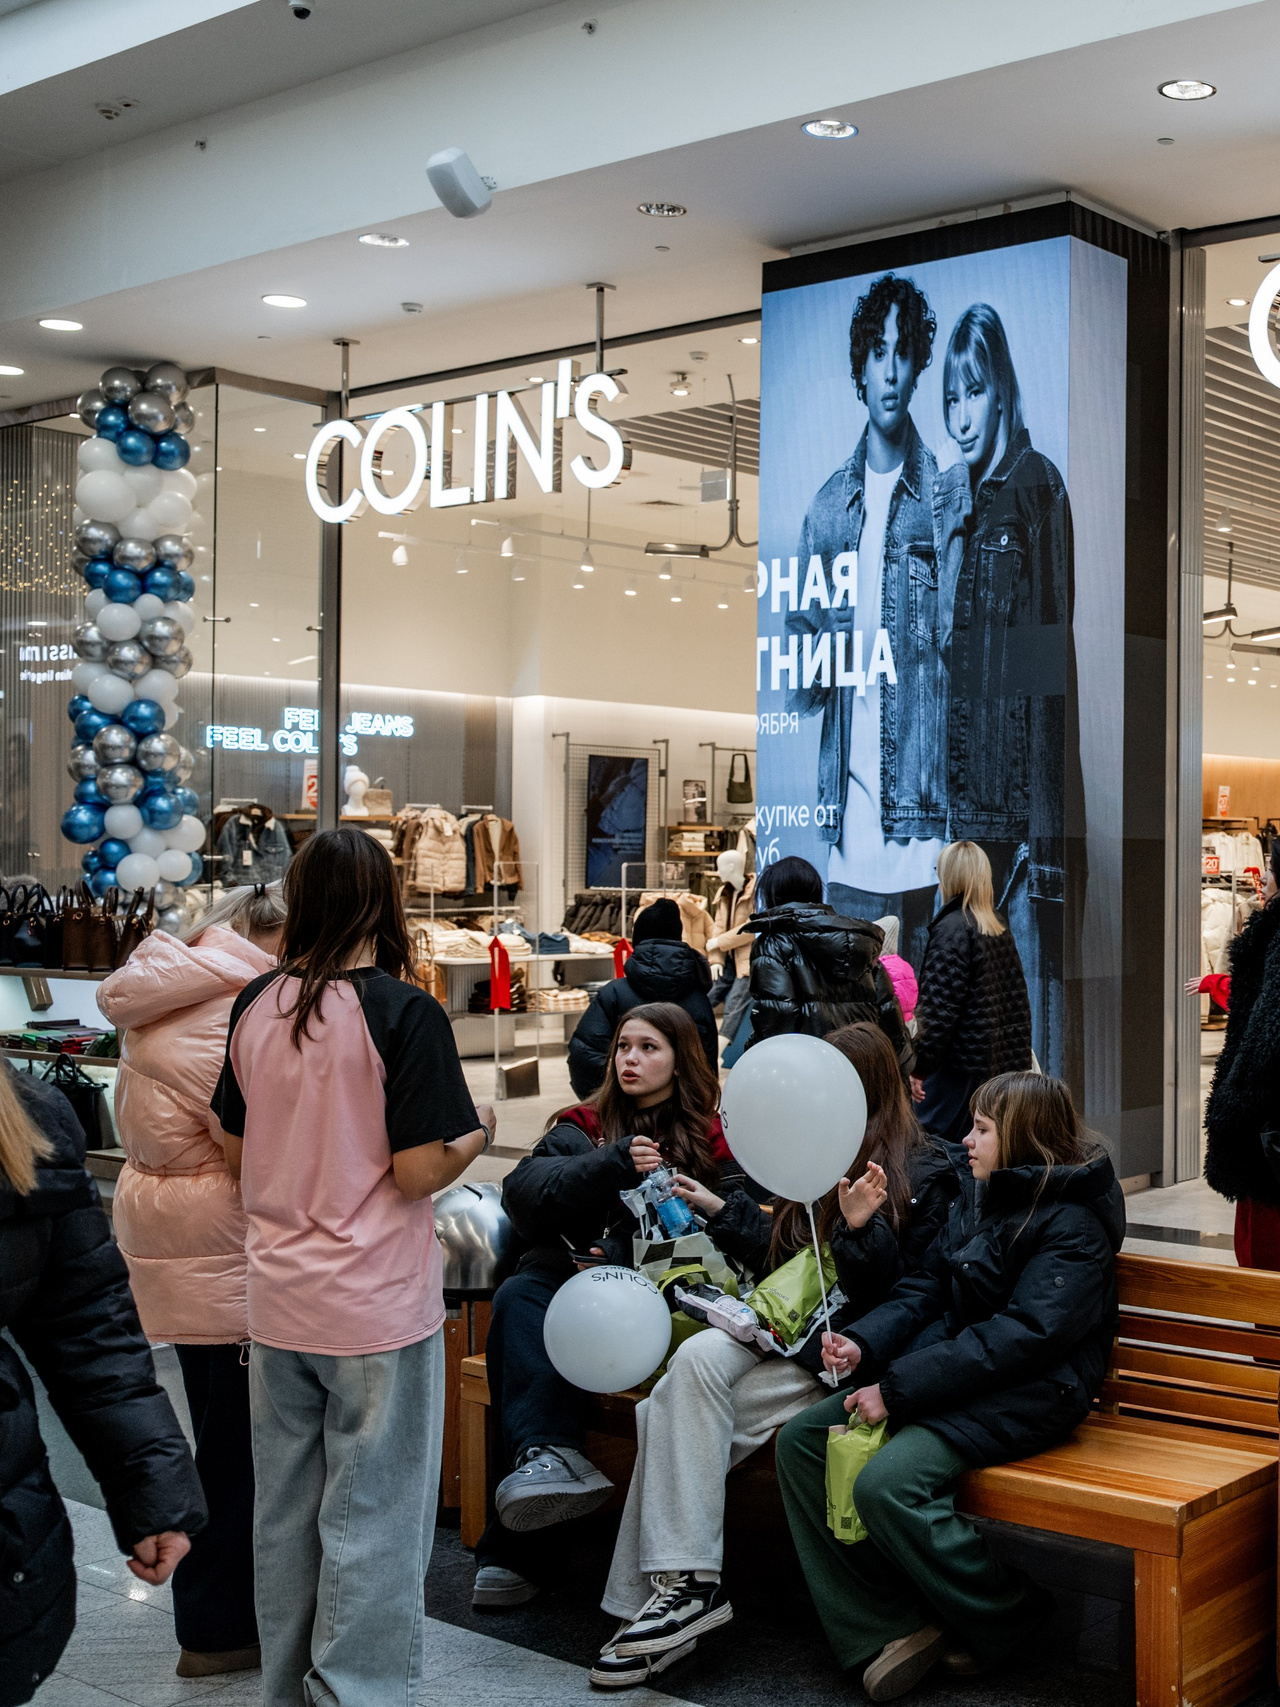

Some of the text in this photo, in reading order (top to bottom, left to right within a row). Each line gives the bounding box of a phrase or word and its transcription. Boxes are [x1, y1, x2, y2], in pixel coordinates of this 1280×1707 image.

[305, 359, 625, 524] COLIN'S
[345, 712, 414, 737] JEANS
[206, 725, 358, 756] FEEL COL'S
[814, 805, 837, 827] от
[756, 838, 781, 871] уб
[591, 1271, 658, 1295] COLIN'S
